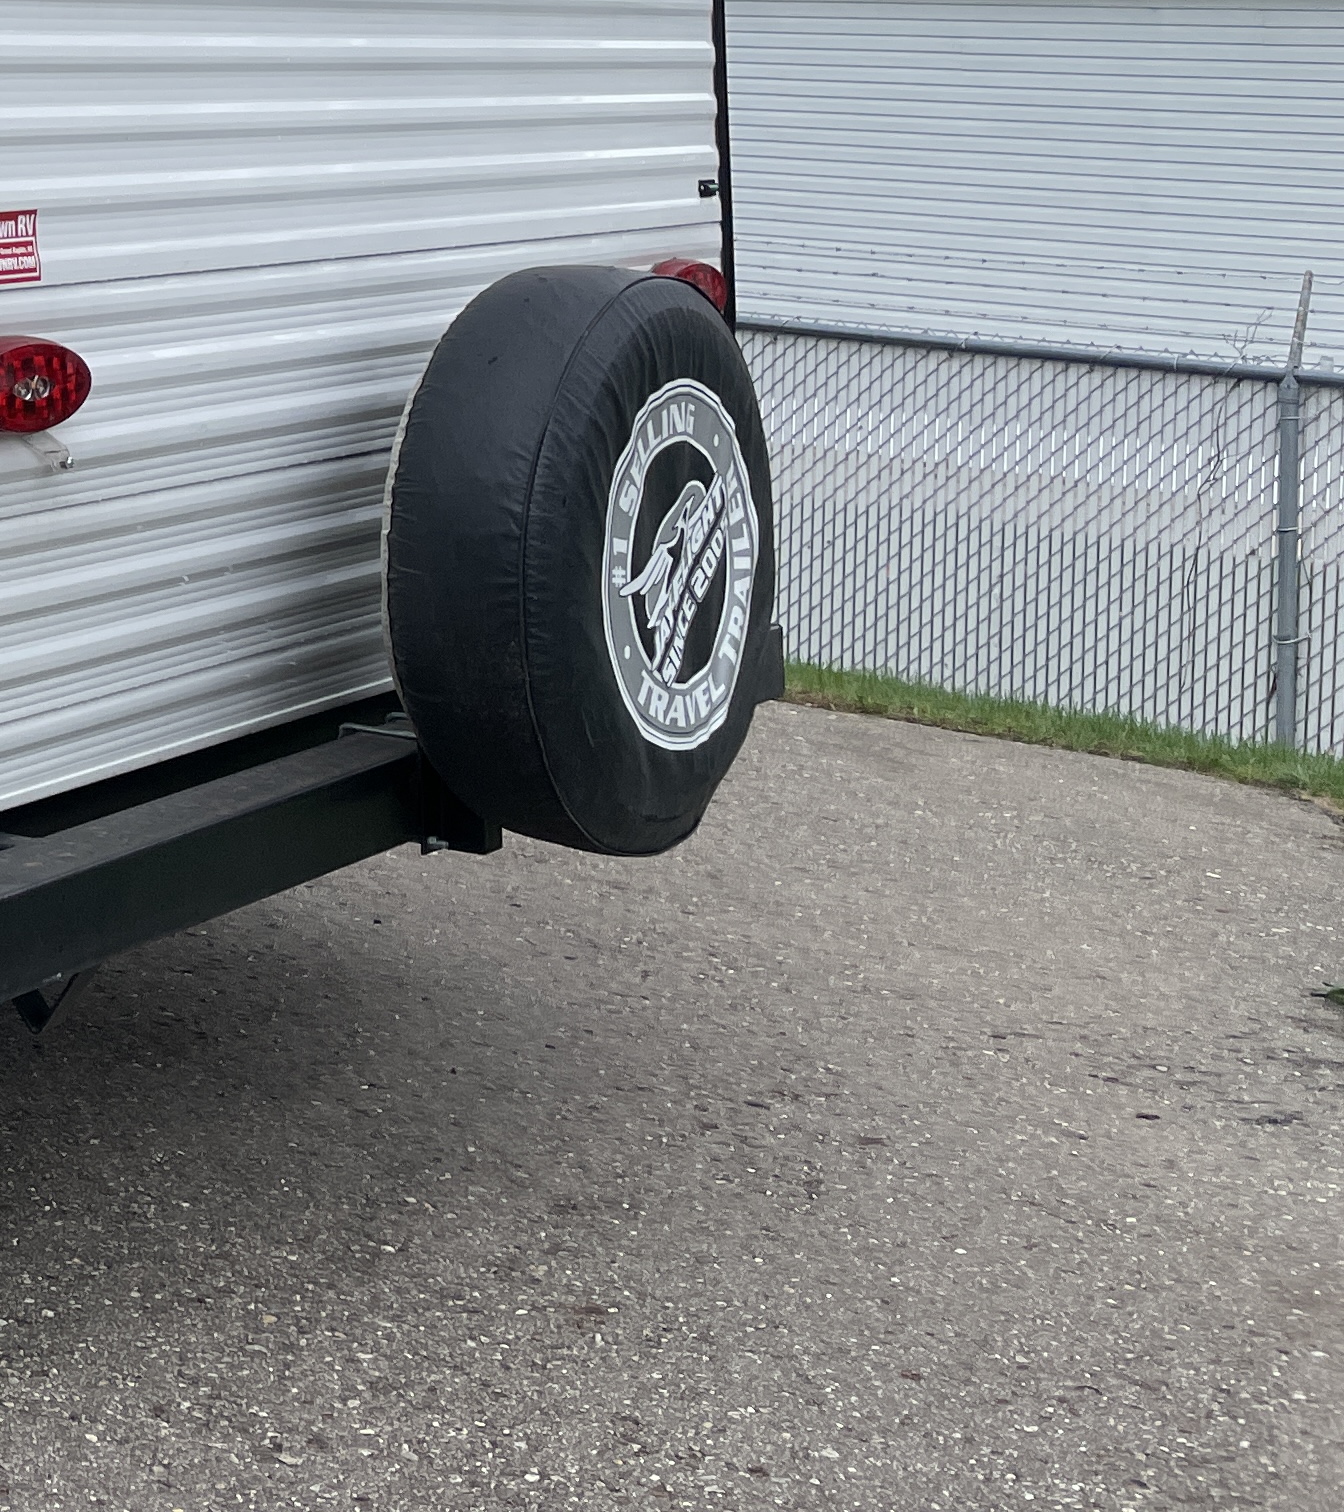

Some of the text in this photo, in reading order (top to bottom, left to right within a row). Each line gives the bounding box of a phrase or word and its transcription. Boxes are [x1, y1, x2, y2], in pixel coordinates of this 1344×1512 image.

[18, 214, 35, 236] RV
[619, 402, 695, 517] SELLING
[662, 592, 695, 687] SINCE
[638, 669, 725, 728] TRAVEL
